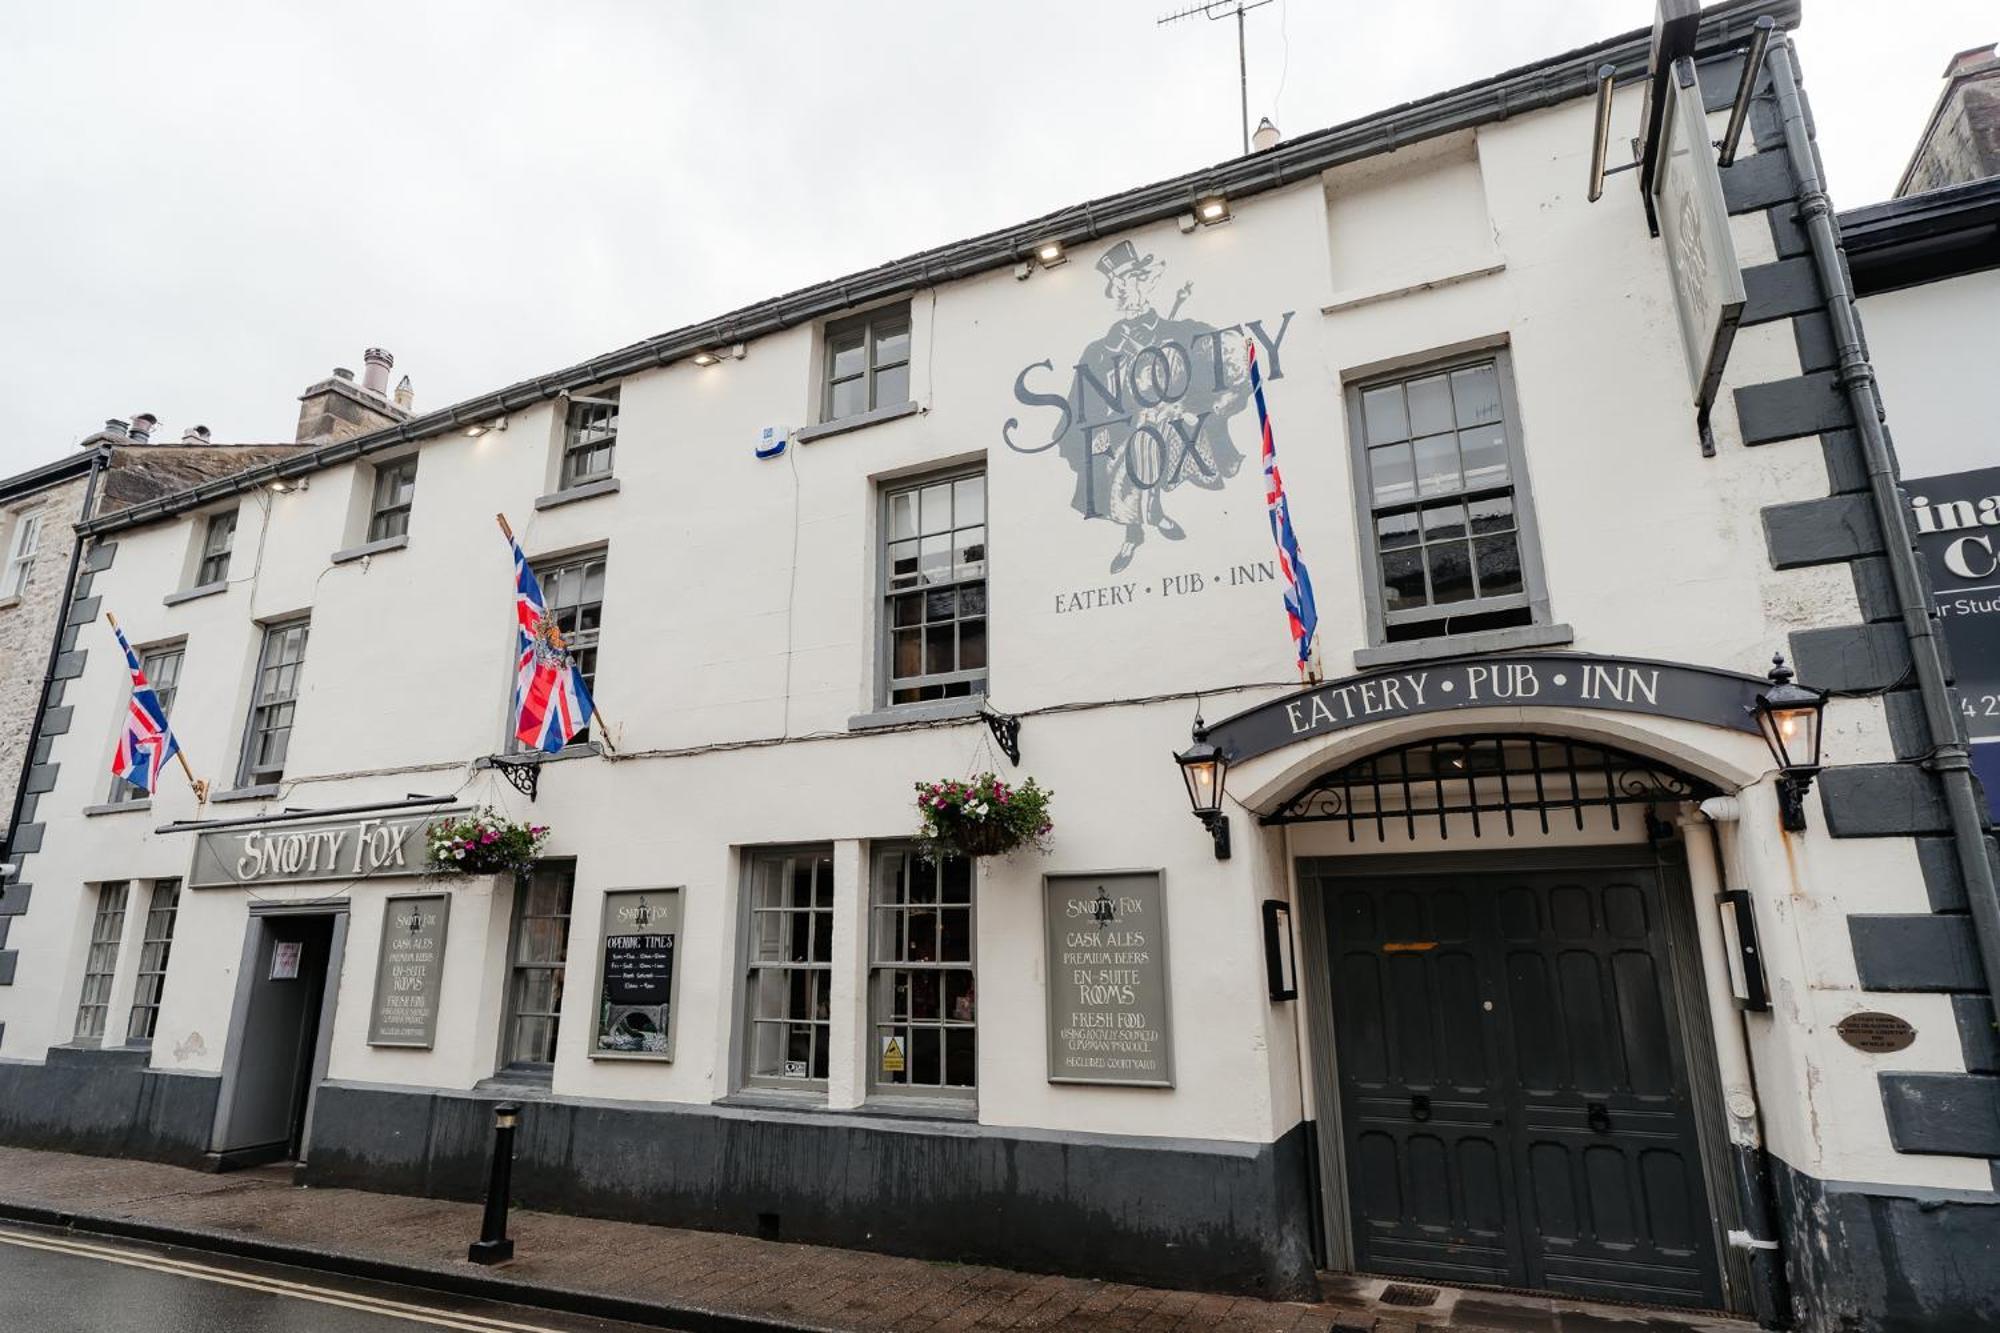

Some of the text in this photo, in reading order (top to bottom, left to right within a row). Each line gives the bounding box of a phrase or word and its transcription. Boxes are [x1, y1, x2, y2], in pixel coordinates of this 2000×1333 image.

[1003, 311, 1296, 454] SNOOTY
[1080, 412, 1217, 520] FOX
[1944, 534, 2000, 578] C
[1055, 560, 1276, 614] EATERY PUB INN
[1285, 664, 1660, 735] EATERY PUB INN
[237, 818, 410, 881] SNOOTY FOX
[1065, 895, 1142, 919] SNOOTY FOX
[607, 935, 673, 949] OPENING TIMES
[1066, 930, 1146, 948] CASK ALES
[1063, 950, 1150, 965] PREMIUM BEERS
[1073, 969, 1140, 986] EN-SUITE
[1079, 984, 1136, 1006] ROOMS
[1071, 1012, 1146, 1029] FRESH FOOD
